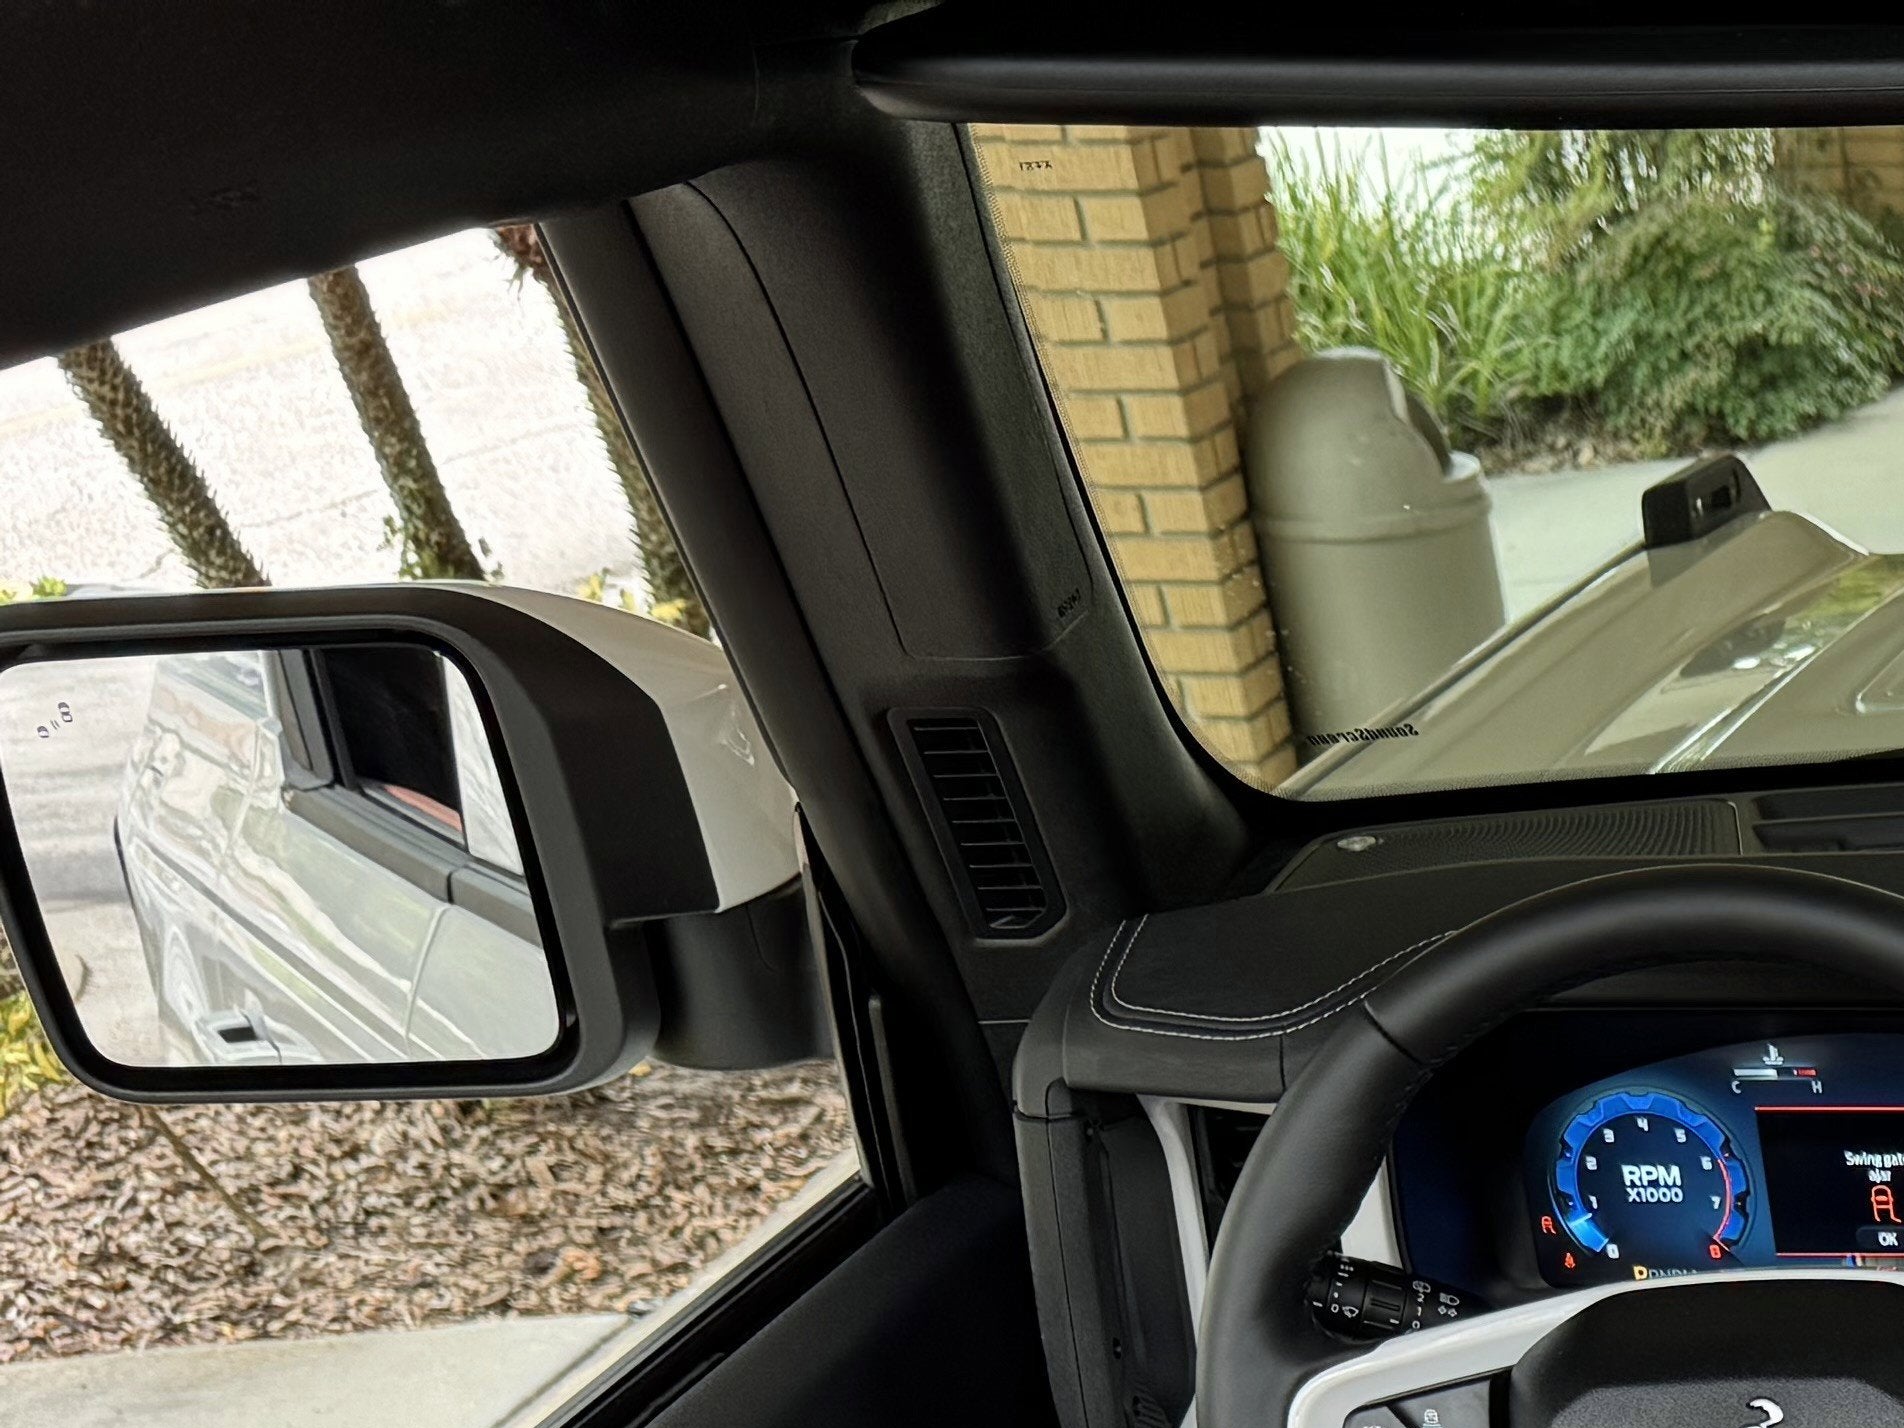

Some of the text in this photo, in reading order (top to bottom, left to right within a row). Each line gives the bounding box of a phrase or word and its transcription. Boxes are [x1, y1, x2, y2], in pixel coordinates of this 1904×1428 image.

[1732, 1080, 1742, 1094] C
[1812, 1081, 1823, 1094] H
[1637, 1116, 1648, 1132] 4
[1603, 1128, 1615, 1143] 3
[1675, 1128, 1686, 1143] 5
[1586, 1156, 1597, 1170] 2
[1700, 1156, 1713, 1170] 6
[1844, 1150, 1882, 1168] Swing
[1622, 1165, 1682, 1186] RPM
[1626, 1187, 1683, 1203] X1000
[1589, 1196, 1598, 1209] 1
[1711, 1196, 1721, 1209] 7
[1878, 1232, 1898, 1246] OK
[1606, 1243, 1619, 1259] 0
